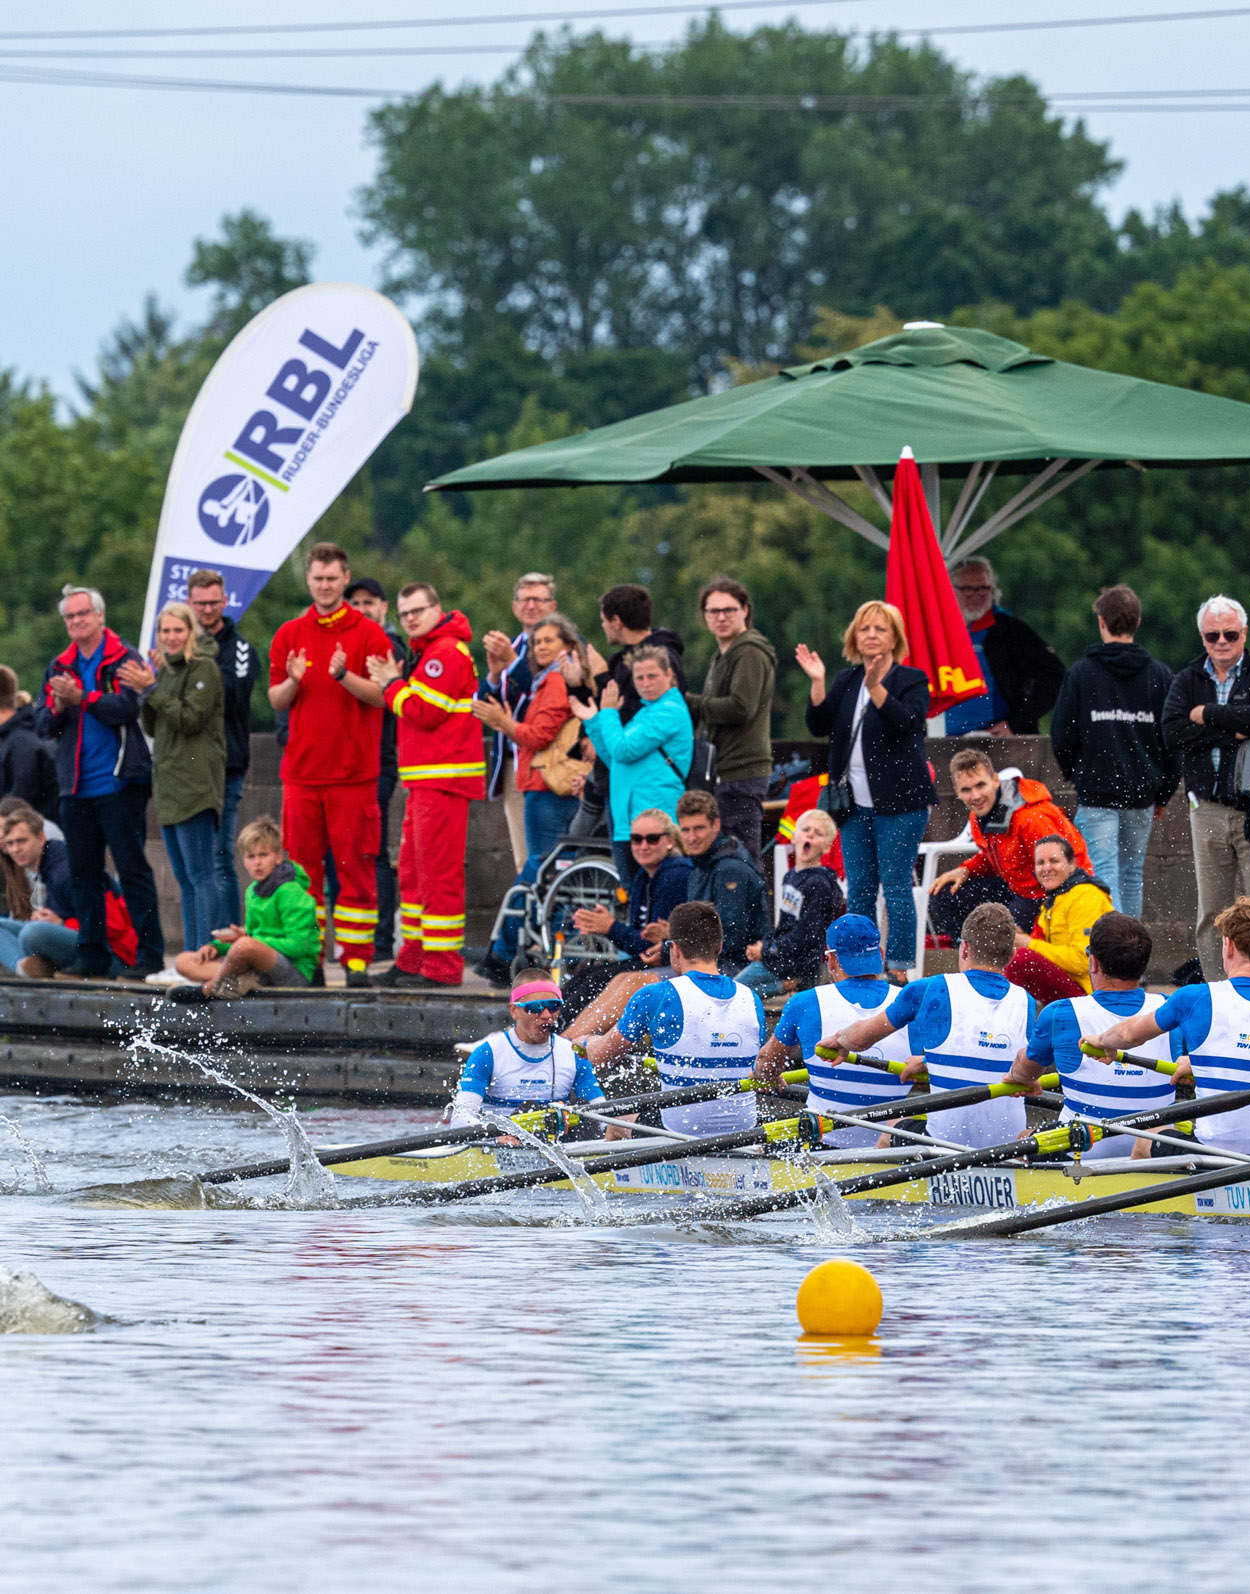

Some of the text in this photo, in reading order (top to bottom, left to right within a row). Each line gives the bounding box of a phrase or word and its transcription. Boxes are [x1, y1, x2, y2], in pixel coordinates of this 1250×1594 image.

[232, 328, 366, 474] RBL
[281, 339, 381, 483] RUDER-BUNDESLIGA
[930, 1174, 1014, 1207] HANNOVER
